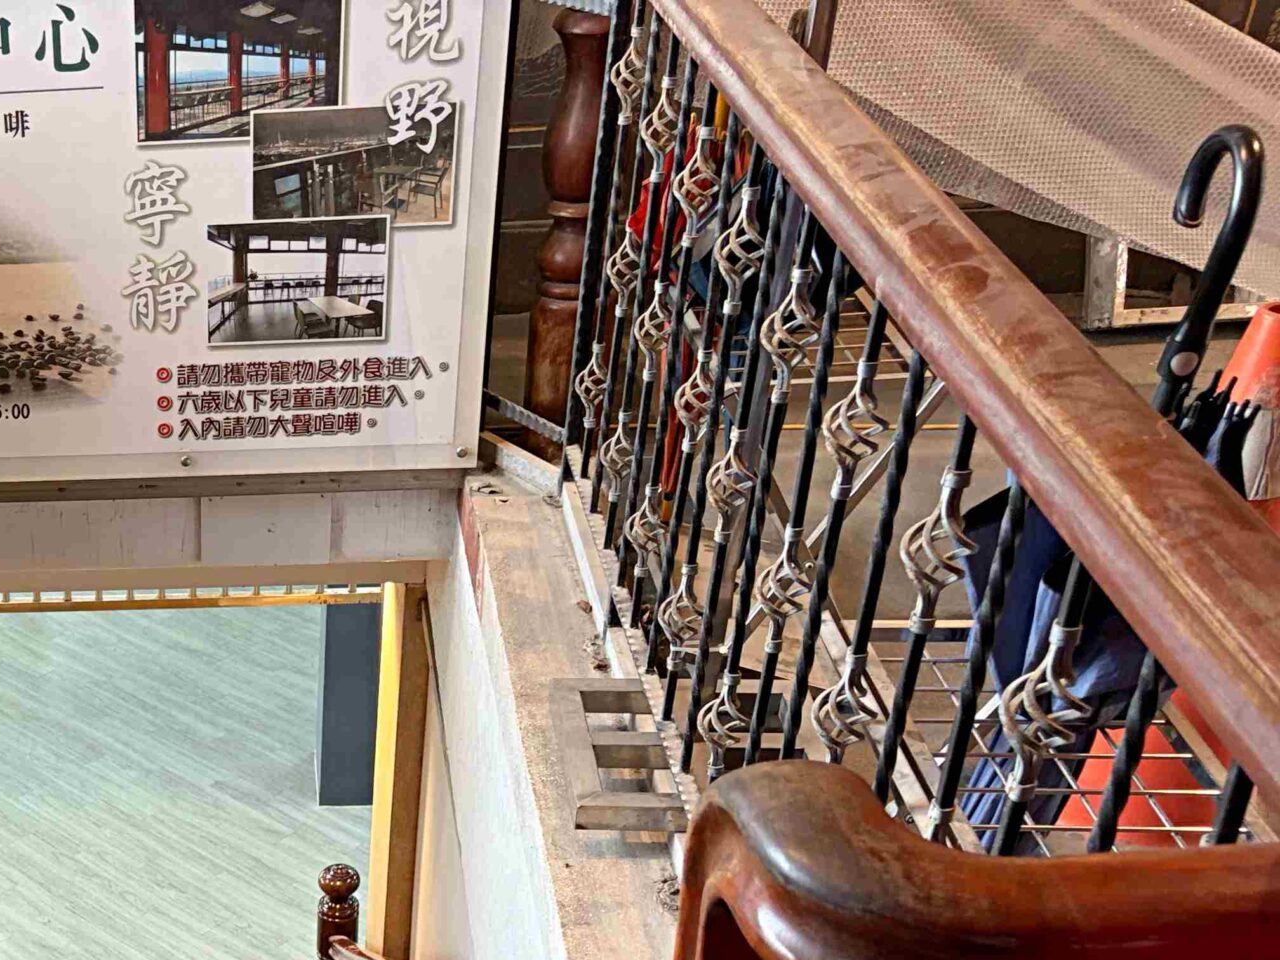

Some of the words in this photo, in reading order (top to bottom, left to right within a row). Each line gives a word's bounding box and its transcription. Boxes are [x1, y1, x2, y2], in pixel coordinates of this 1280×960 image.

[386, 0, 460, 155] 視野
[122, 160, 196, 332] 寧靜
[177, 384, 426, 414] 六歲以下兒童請勿進入。
